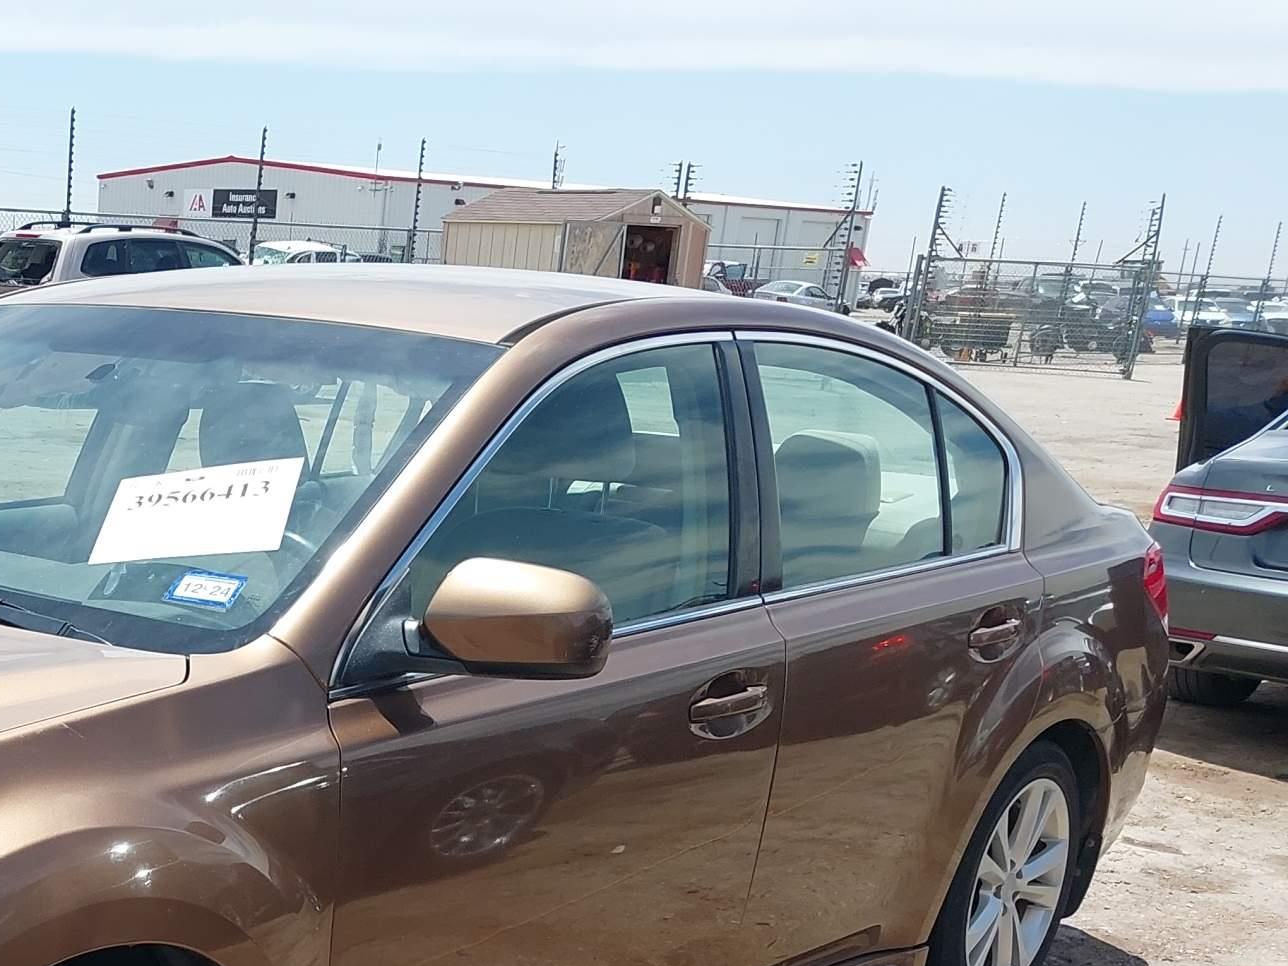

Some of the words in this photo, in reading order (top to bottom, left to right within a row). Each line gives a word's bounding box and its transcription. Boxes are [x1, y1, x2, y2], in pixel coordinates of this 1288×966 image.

[229, 192, 260, 202] Insuranc
[222, 203, 237, 213] Auto
[238, 203, 266, 214] Auctins
[127, 480, 271, 511] 39566413
